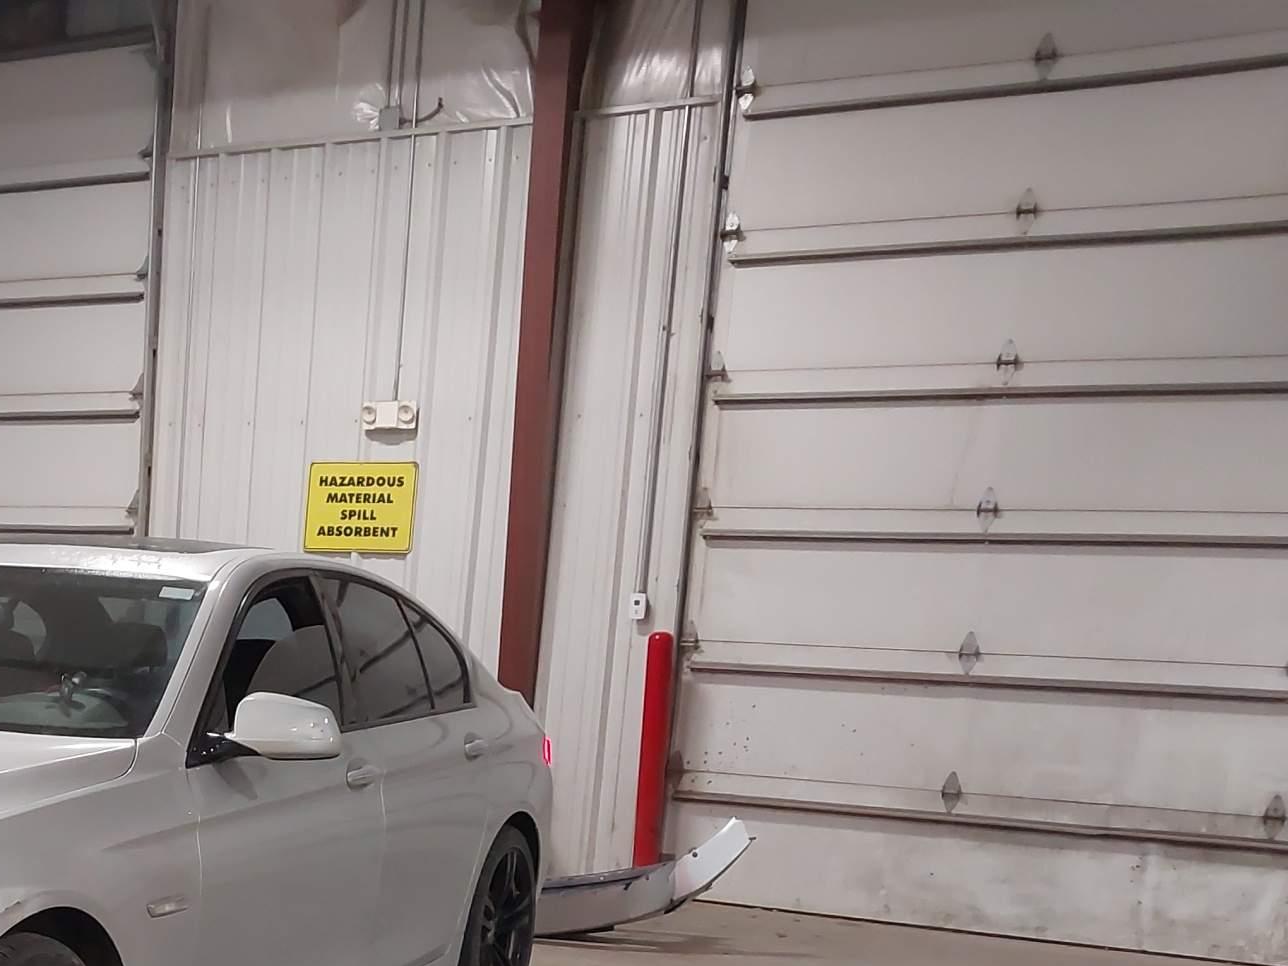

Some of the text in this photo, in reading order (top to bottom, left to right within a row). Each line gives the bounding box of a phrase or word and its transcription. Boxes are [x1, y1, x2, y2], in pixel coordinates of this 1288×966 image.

[319, 476, 405, 487] HAZARDOUS
[326, 493, 394, 503] MATERIAL
[340, 509, 376, 520] SPILL
[317, 526, 398, 537] ABSORBENT
